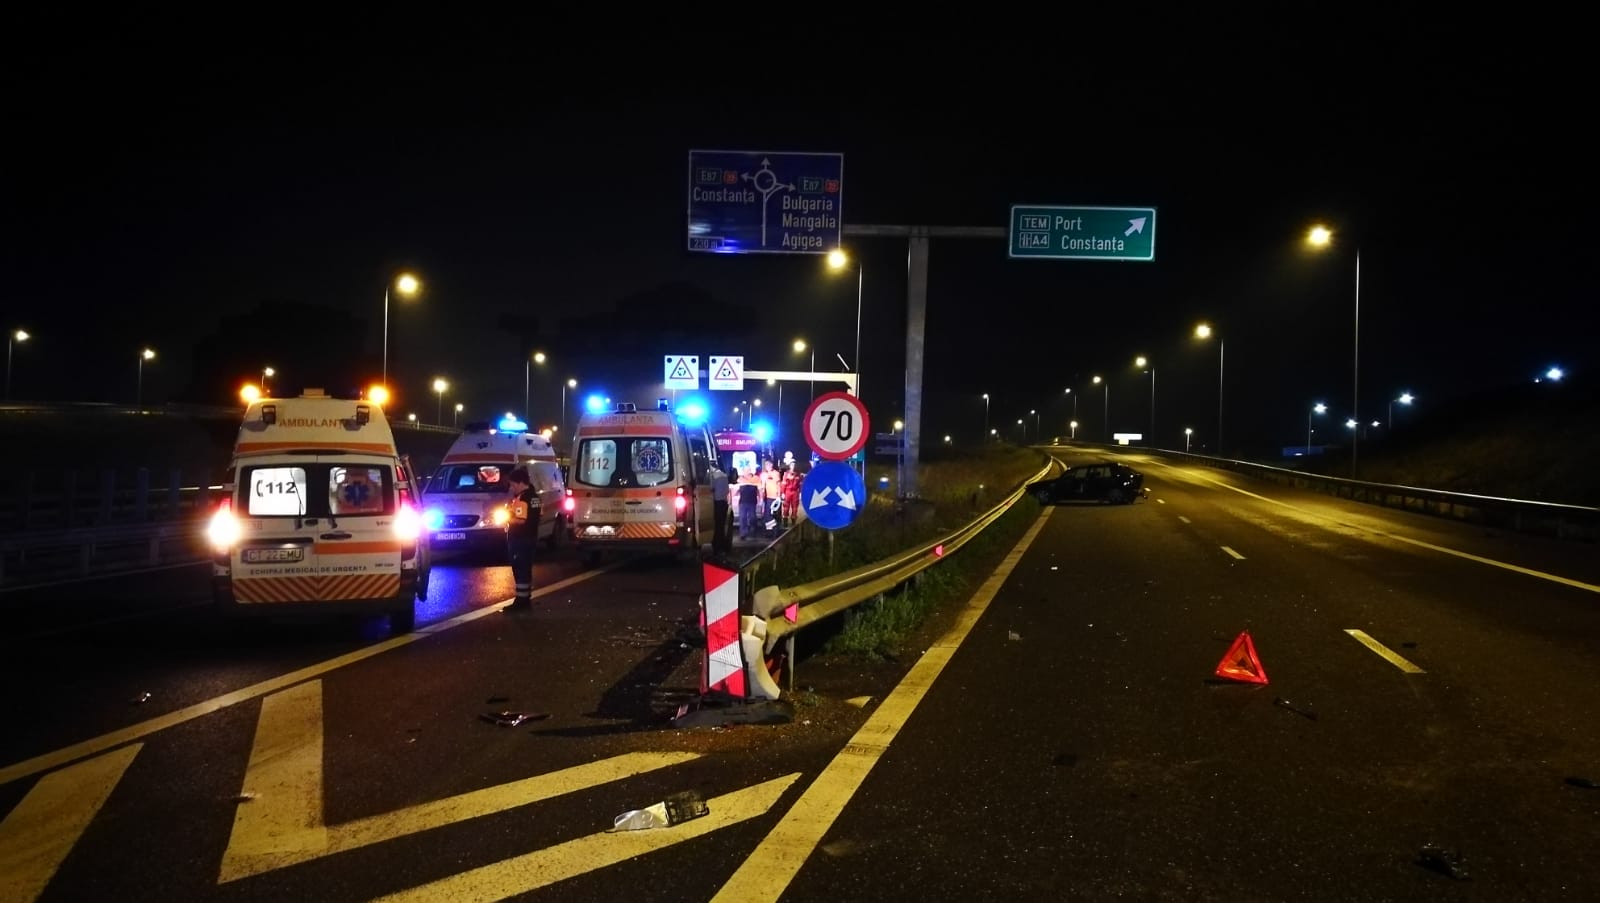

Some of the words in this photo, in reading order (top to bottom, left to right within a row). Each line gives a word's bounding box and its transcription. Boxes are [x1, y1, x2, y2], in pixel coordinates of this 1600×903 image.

[782, 195, 833, 213] Bulgaria
[782, 213, 836, 231] Mangalia
[1024, 217, 1047, 228] TEM
[1055, 216, 1082, 231] Port
[782, 232, 823, 249] Agigea
[1032, 235, 1048, 246] A4
[820, 410, 853, 441] 70
[590, 458, 609, 470] 112
[265, 482, 296, 494] 112
[279, 549, 302, 560] EMU
[250, 568, 282, 576] ECHIPAJ
[285, 567, 318, 575] MEDICAL
